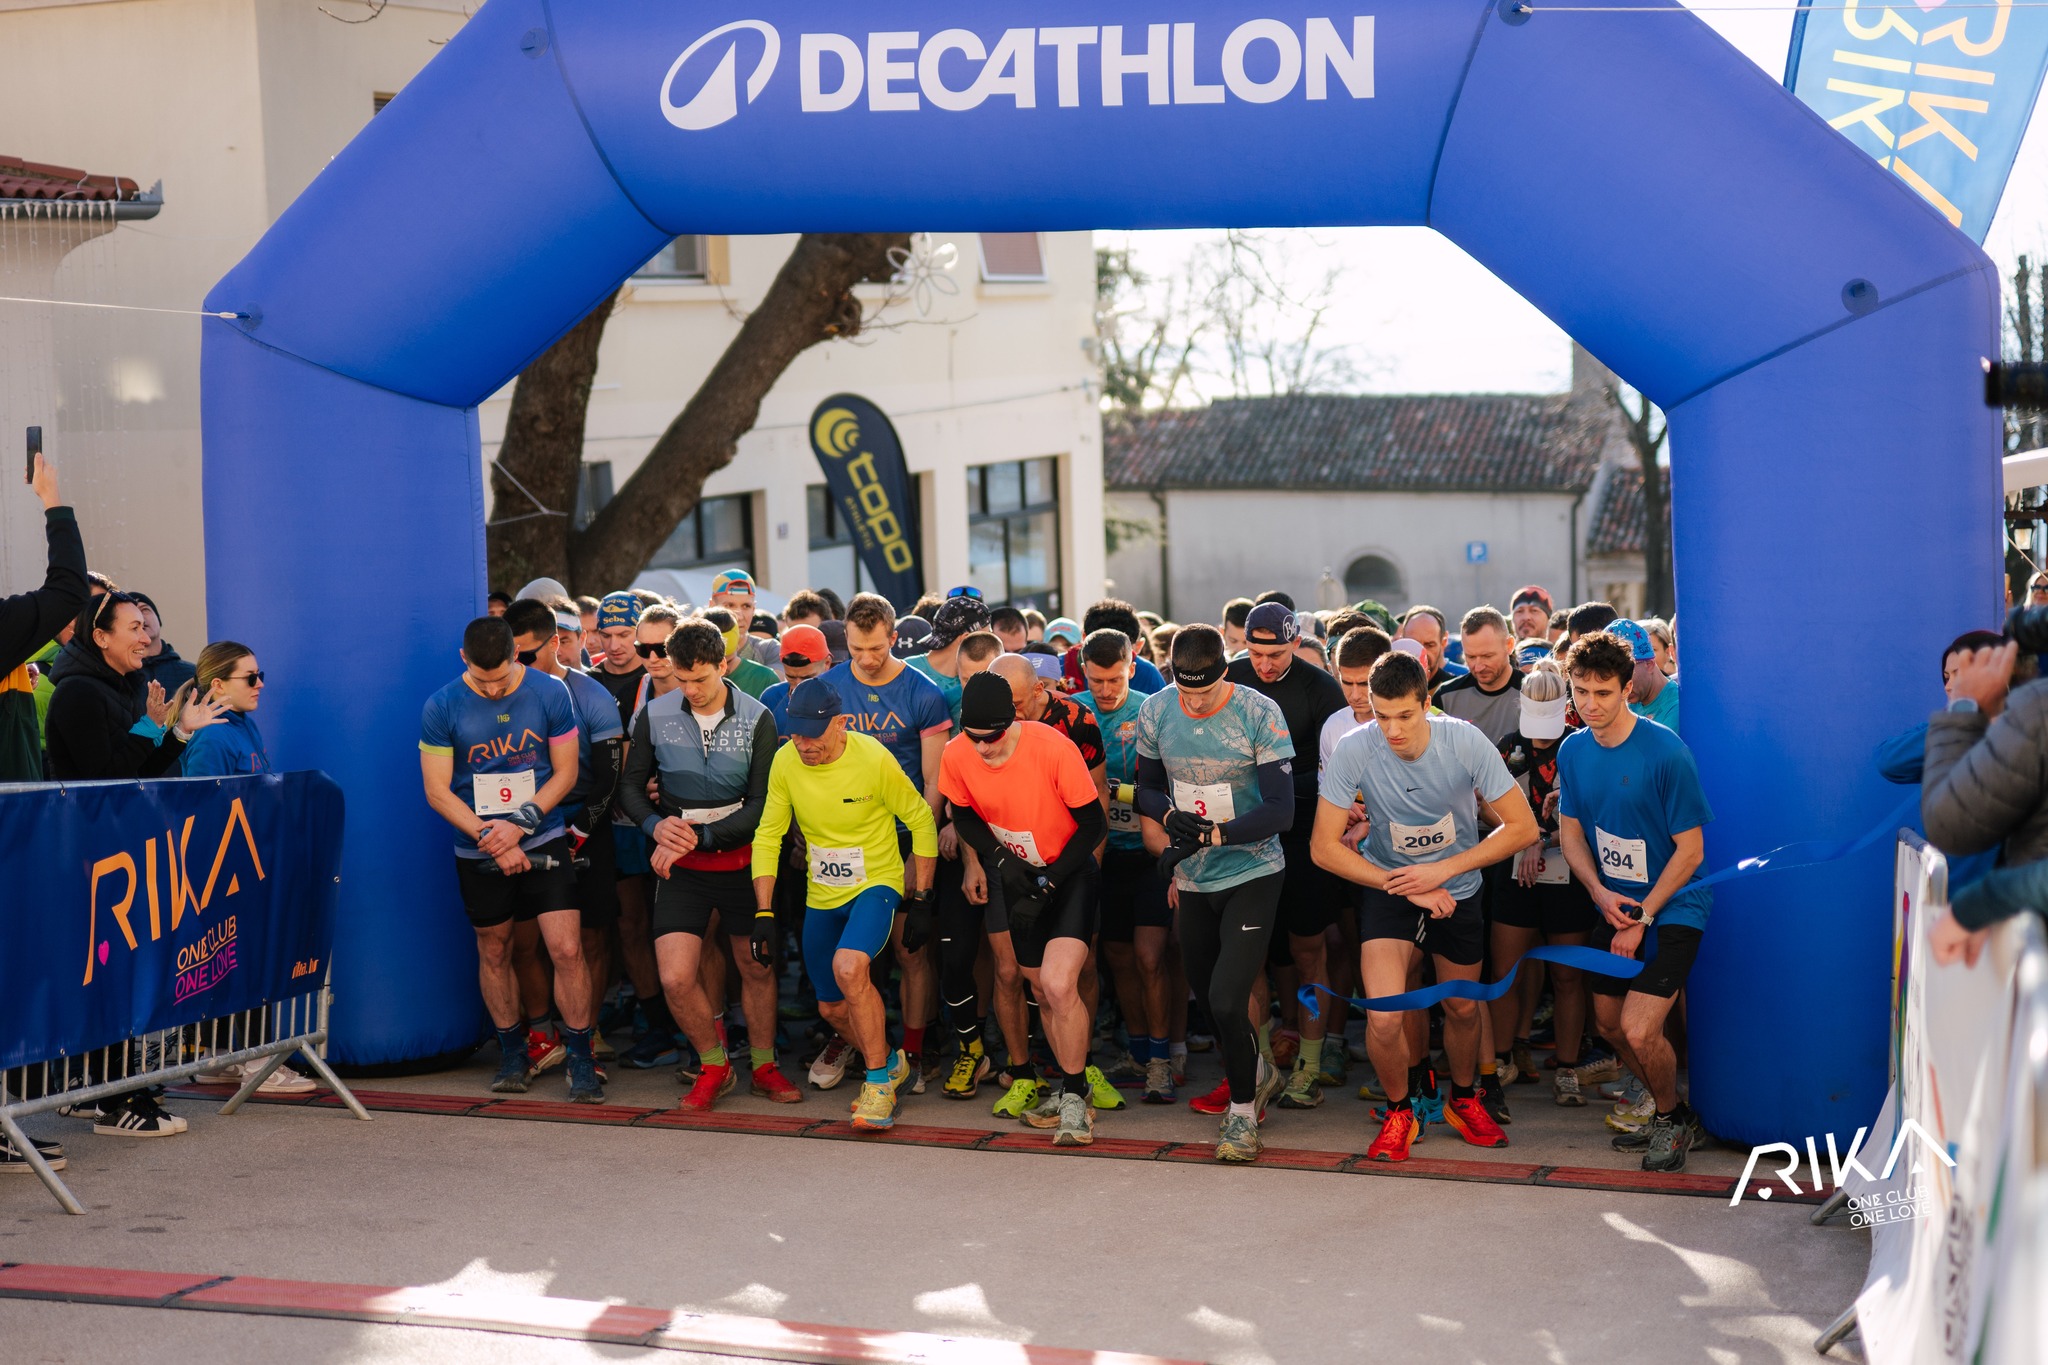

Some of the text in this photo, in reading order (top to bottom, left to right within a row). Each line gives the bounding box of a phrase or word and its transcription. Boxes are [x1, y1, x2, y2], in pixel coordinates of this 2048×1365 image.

[800, 15, 1376, 112] DECATHLON
[847, 451, 914, 574] topo
[1178, 672, 1205, 681] ROCKAY
[467, 728, 544, 763] RIKA
[500, 788, 512, 803] 9
[1194, 800, 1207, 817] 3
[1404, 832, 1444, 848] 206
[820, 861, 853, 877] 205
[1603, 847, 1634, 869] 294
[83, 797, 265, 986] RIKA
[177, 914, 237, 970] ONE CLUB
[175, 942, 237, 998] ONE LOVE
